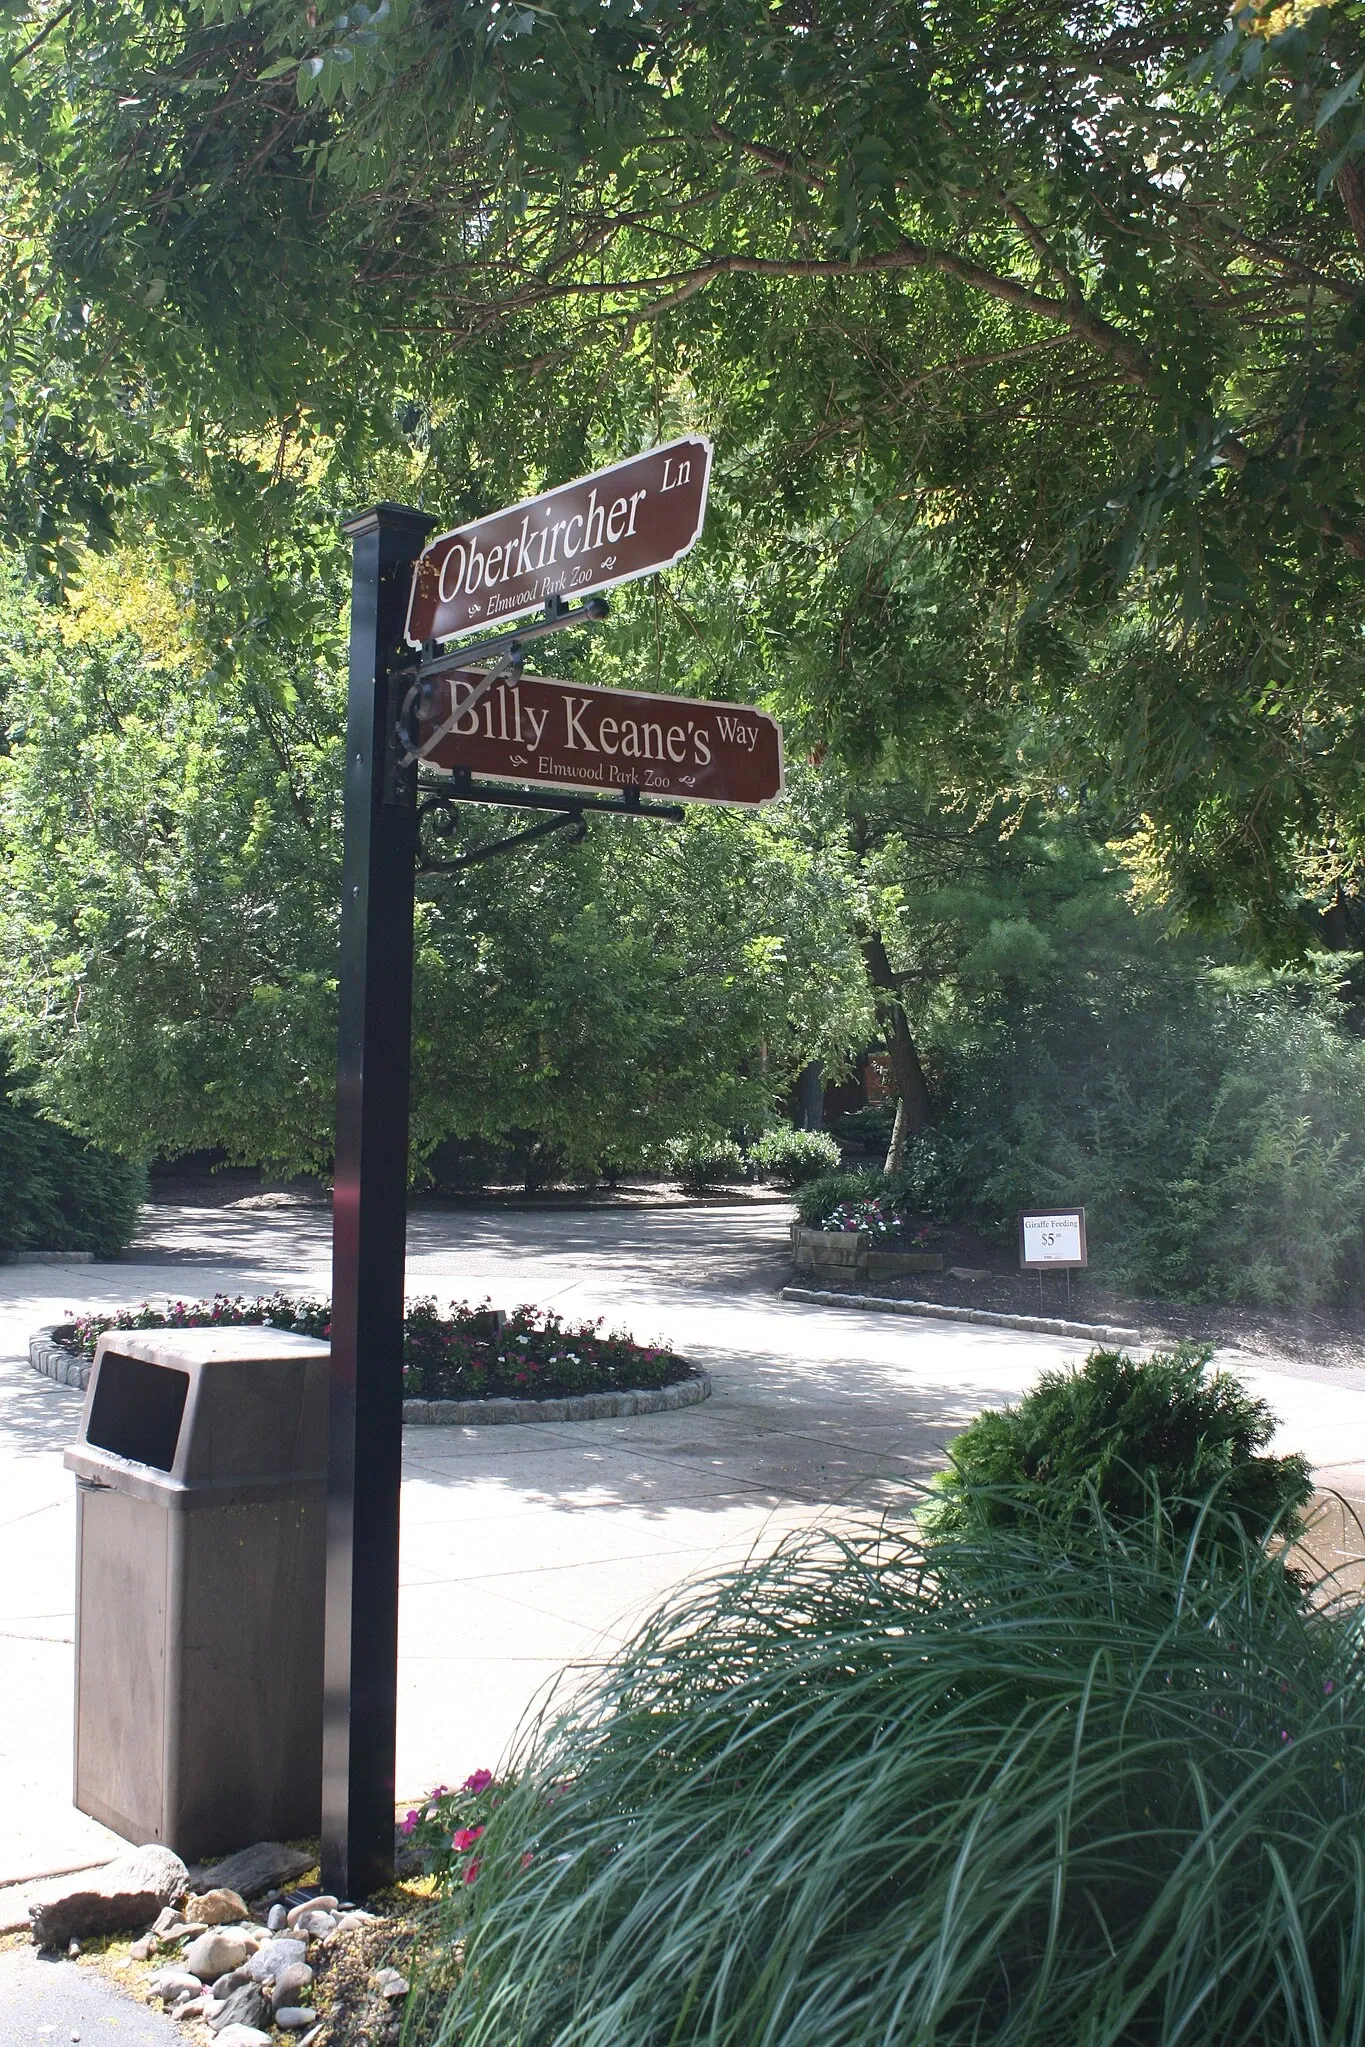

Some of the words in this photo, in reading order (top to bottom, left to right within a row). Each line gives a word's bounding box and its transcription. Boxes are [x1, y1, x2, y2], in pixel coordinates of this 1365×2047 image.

[438, 488, 647, 603] Oberkircher
[659, 457, 691, 493] Ln
[486, 583, 537, 616] Elmwood
[540, 574, 566, 597] Park
[569, 565, 594, 587] Zoo
[445, 678, 550, 752] Billy
[562, 696, 712, 766] Keane's
[715, 715, 760, 752] Way
[538, 756, 603, 781] Elmwood
[609, 765, 639, 785] Park
[644, 770, 670, 789] Zoo
[1025, 1220, 1050, 1229] Giraffe
[1051, 1219, 1078, 1229] Feeding
